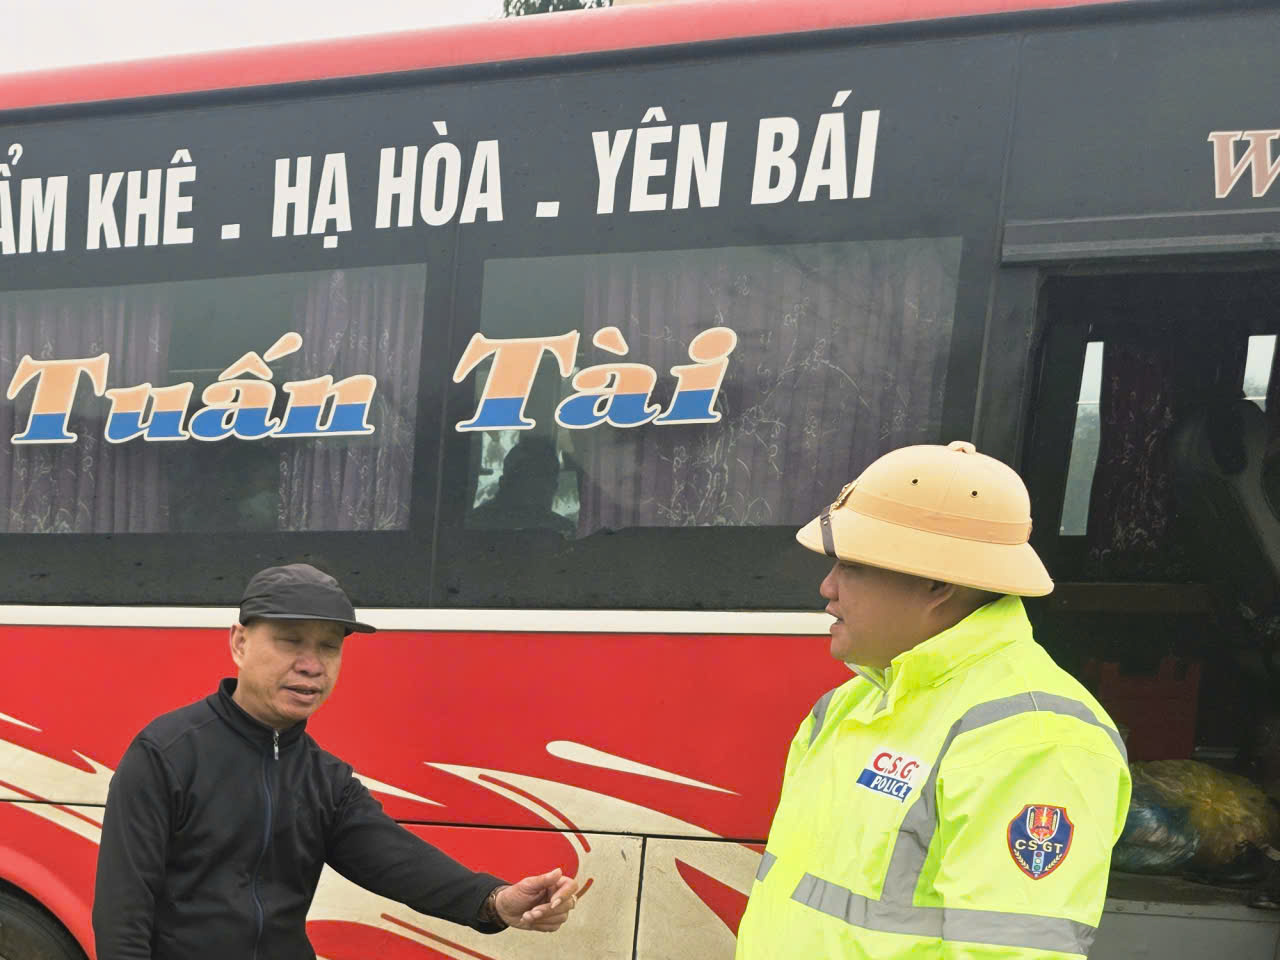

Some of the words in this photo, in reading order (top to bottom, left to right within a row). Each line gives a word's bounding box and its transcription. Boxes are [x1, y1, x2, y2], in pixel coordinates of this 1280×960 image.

[86, 148, 197, 250] KHÊ
[271, 152, 353, 249] HẠ
[374, 120, 504, 229] HÒA
[591, 106, 728, 215] YÊN
[750, 89, 881, 205] BÁI
[6, 331, 377, 445] Tuấn
[452, 326, 738, 433] Tài
